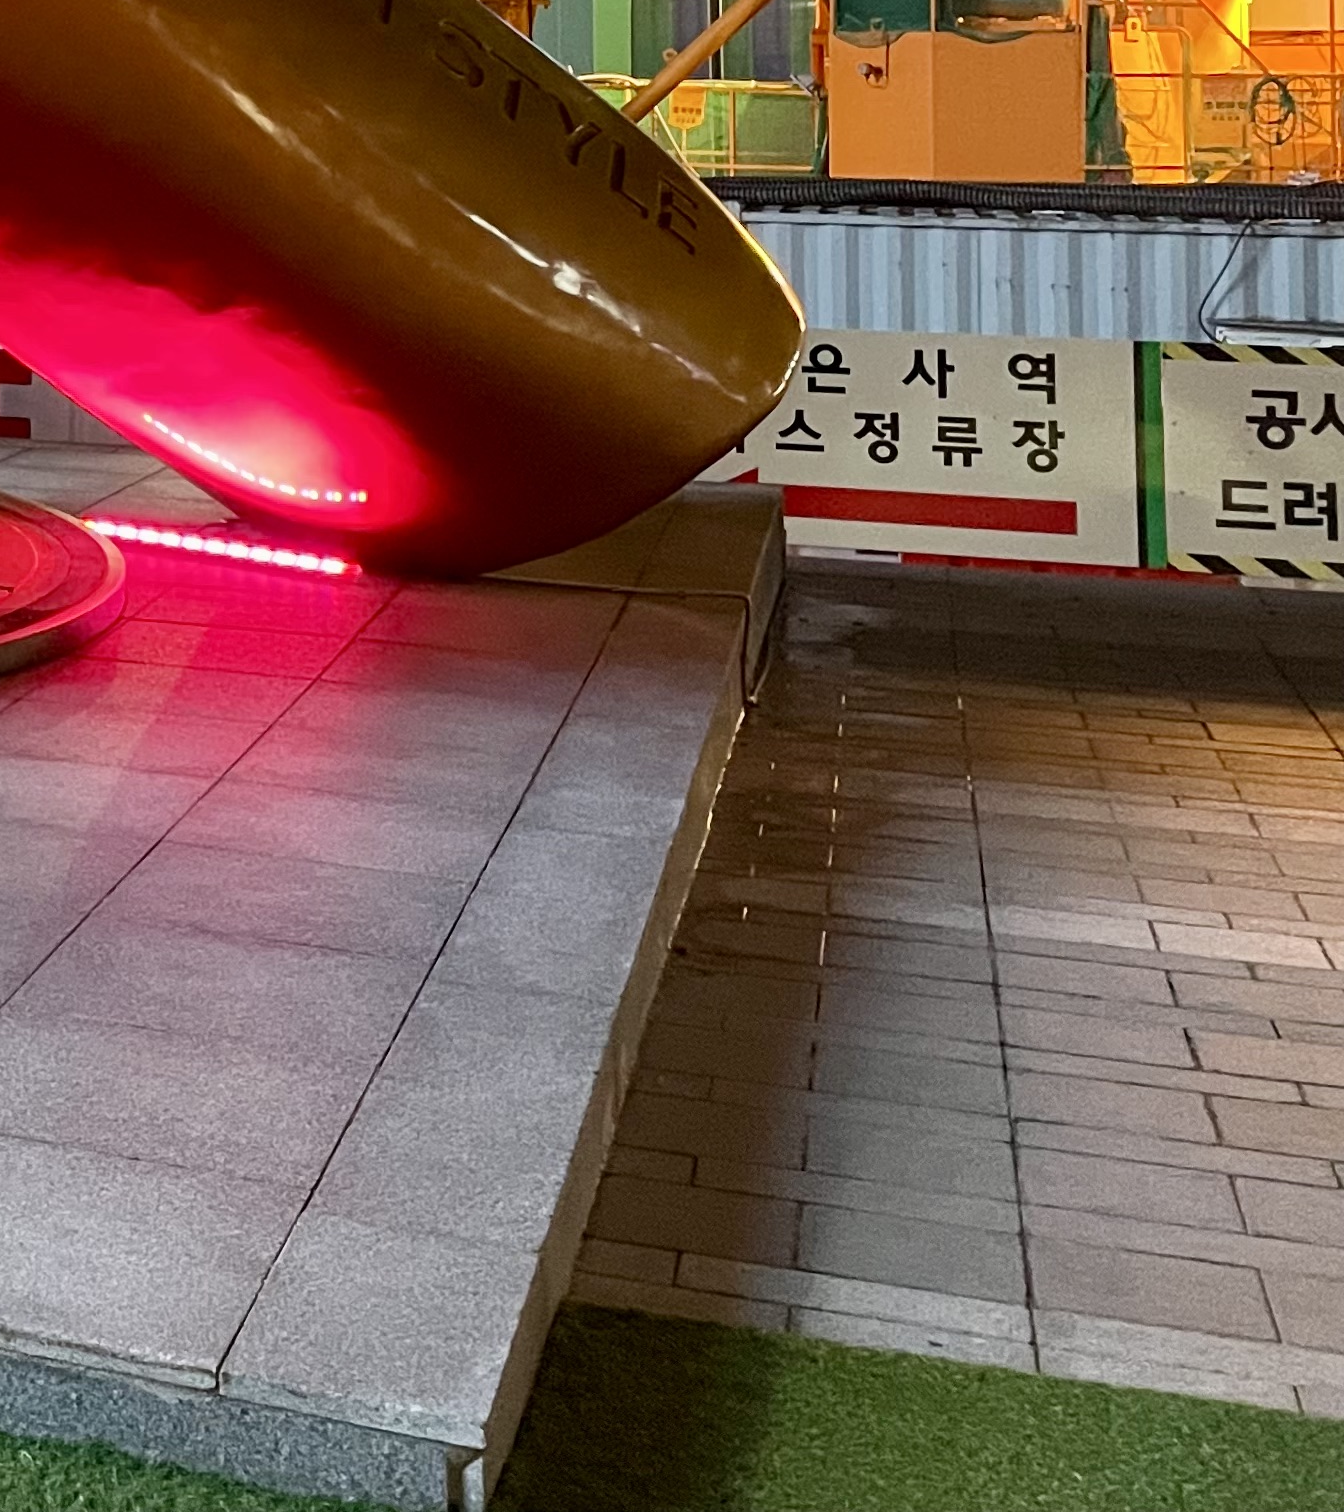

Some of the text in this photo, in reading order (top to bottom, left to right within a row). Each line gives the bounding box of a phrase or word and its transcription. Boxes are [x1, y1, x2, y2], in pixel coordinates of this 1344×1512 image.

[434, 20, 699, 255] STYLE
[735, 409, 1066, 473] 스정류장
[1215, 479, 1339, 541] 드려
